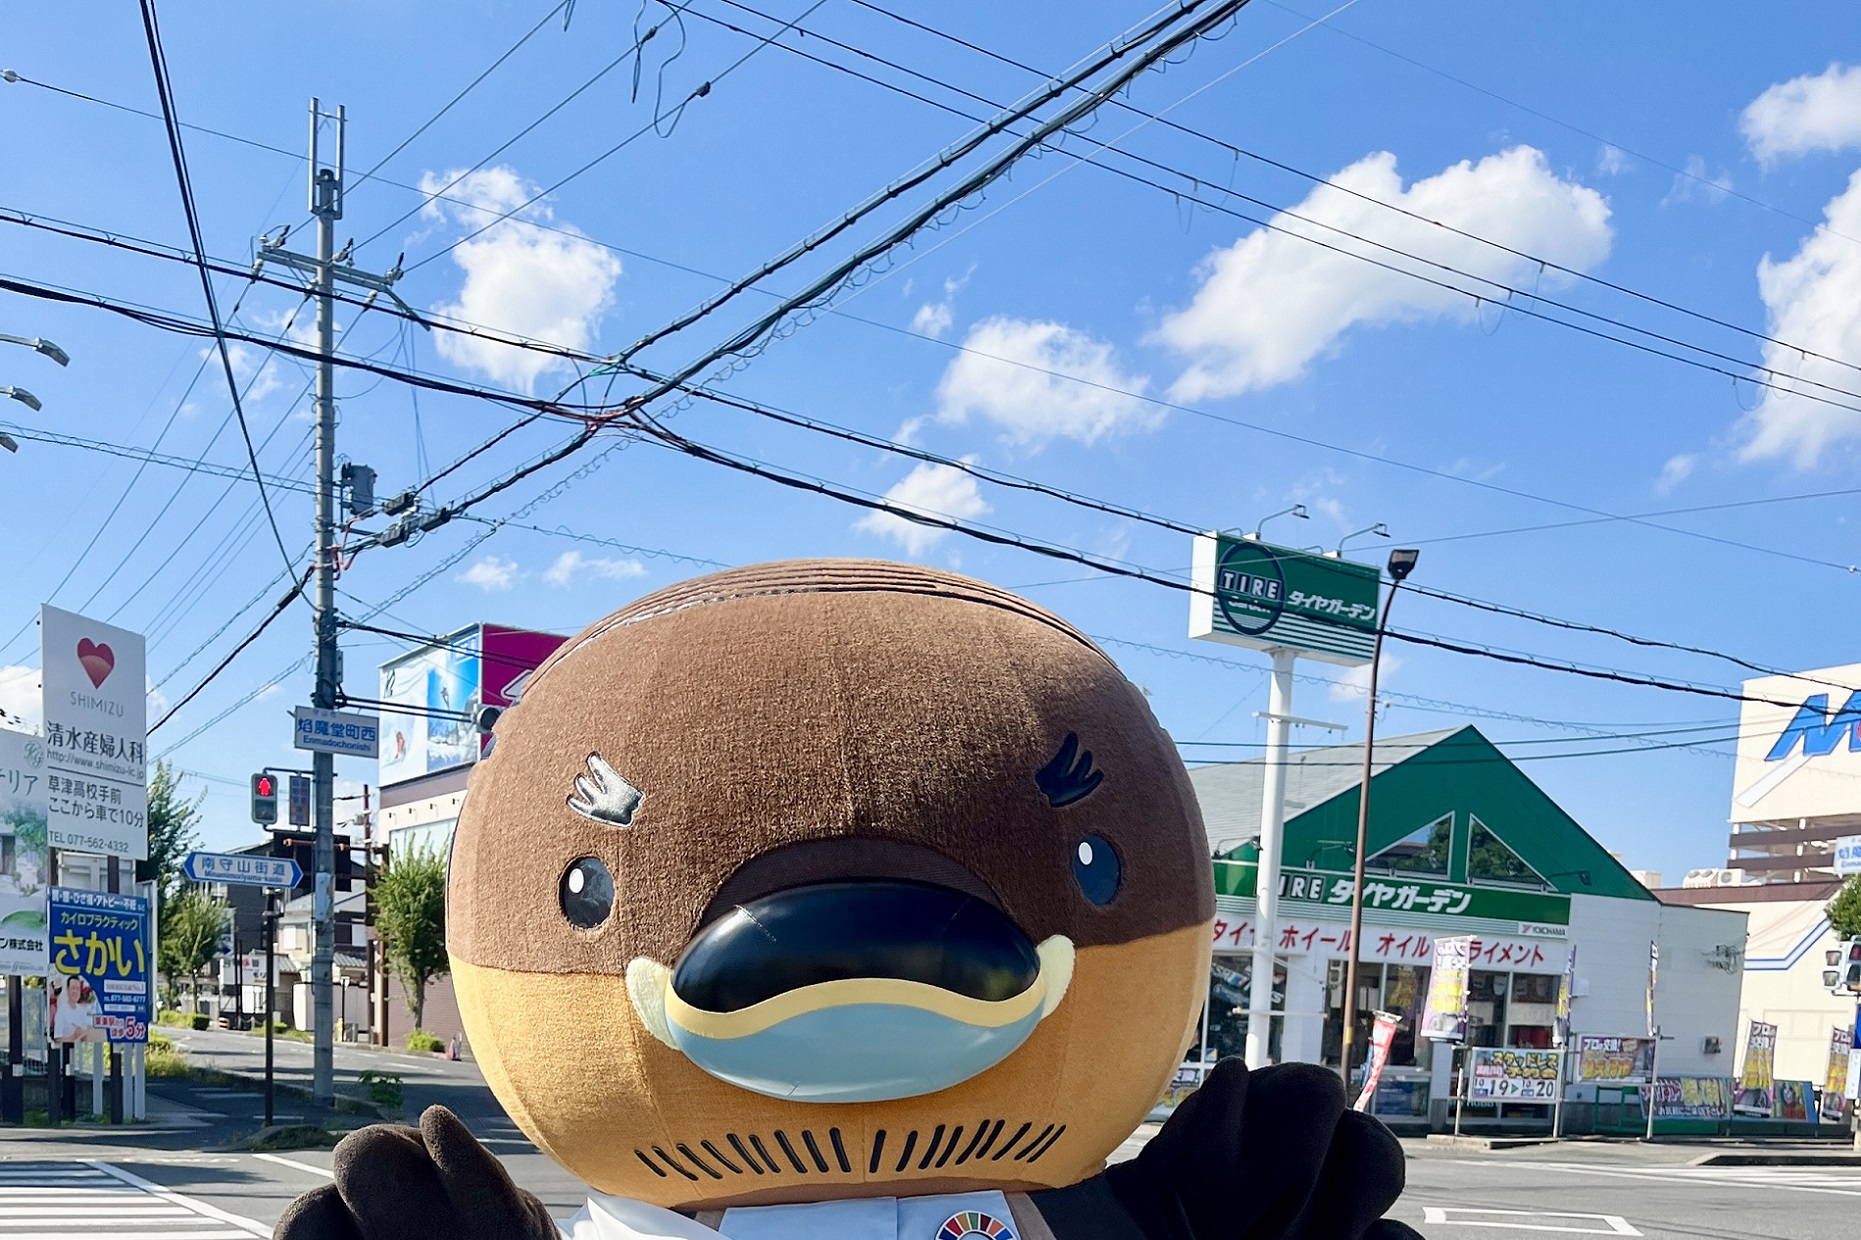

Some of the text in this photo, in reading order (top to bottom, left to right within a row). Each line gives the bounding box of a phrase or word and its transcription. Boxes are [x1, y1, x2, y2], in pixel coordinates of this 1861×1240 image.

[1223, 572, 1279, 599] TIRE
[1288, 590, 1376, 621] タイヤガーデン
[70, 691, 124, 718] SHIMIZU
[47, 720, 143, 765] 清水産婦人科
[48, 775, 121, 805] 草津高校手前
[49, 797, 144, 828] ここから車で10分
[49, 831, 129, 853] TEL 077-562-4332
[202, 857, 286, 876] 南守山街道
[1278, 875, 1323, 899] IRE
[61, 911, 138, 931] カイロプラクティック
[54, 929, 145, 977] さかい
[1213, 919, 1256, 947] タイ
[1376, 933, 1430, 957] オイル
[1468, 941, 1544, 967] ライメント
[1493, 1051, 1558, 1067] スタッドレス
[1536, 1081, 1554, 1097] 20
